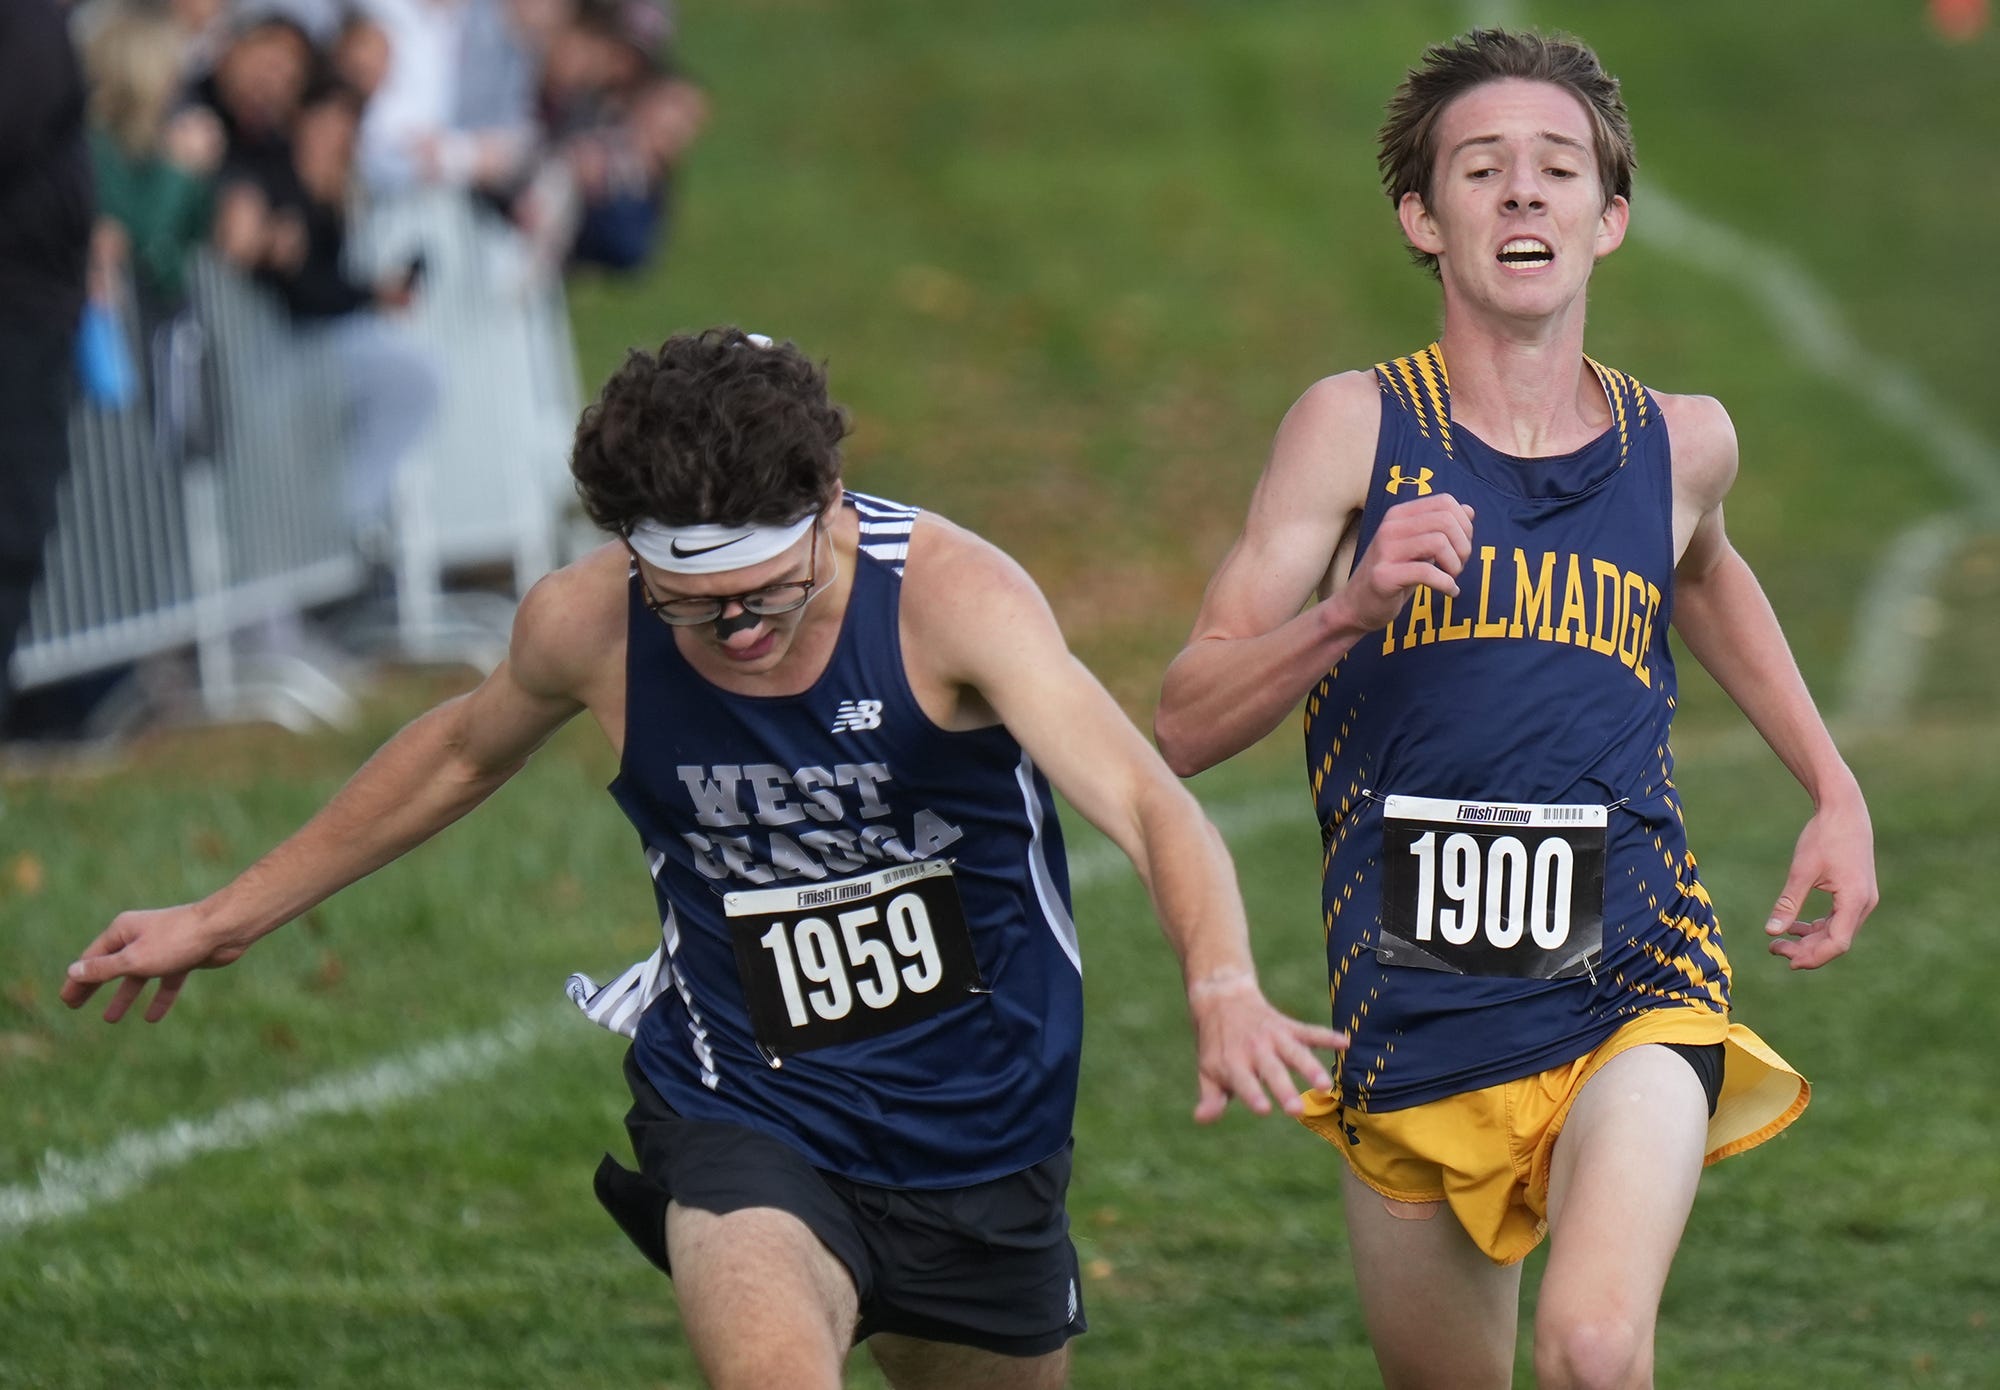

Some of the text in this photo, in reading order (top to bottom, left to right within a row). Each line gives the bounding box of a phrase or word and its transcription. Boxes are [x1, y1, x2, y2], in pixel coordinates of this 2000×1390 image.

[677, 763, 892, 827] WEST
[1410, 831, 1574, 950] 1900
[760, 893, 943, 1027] 1959
